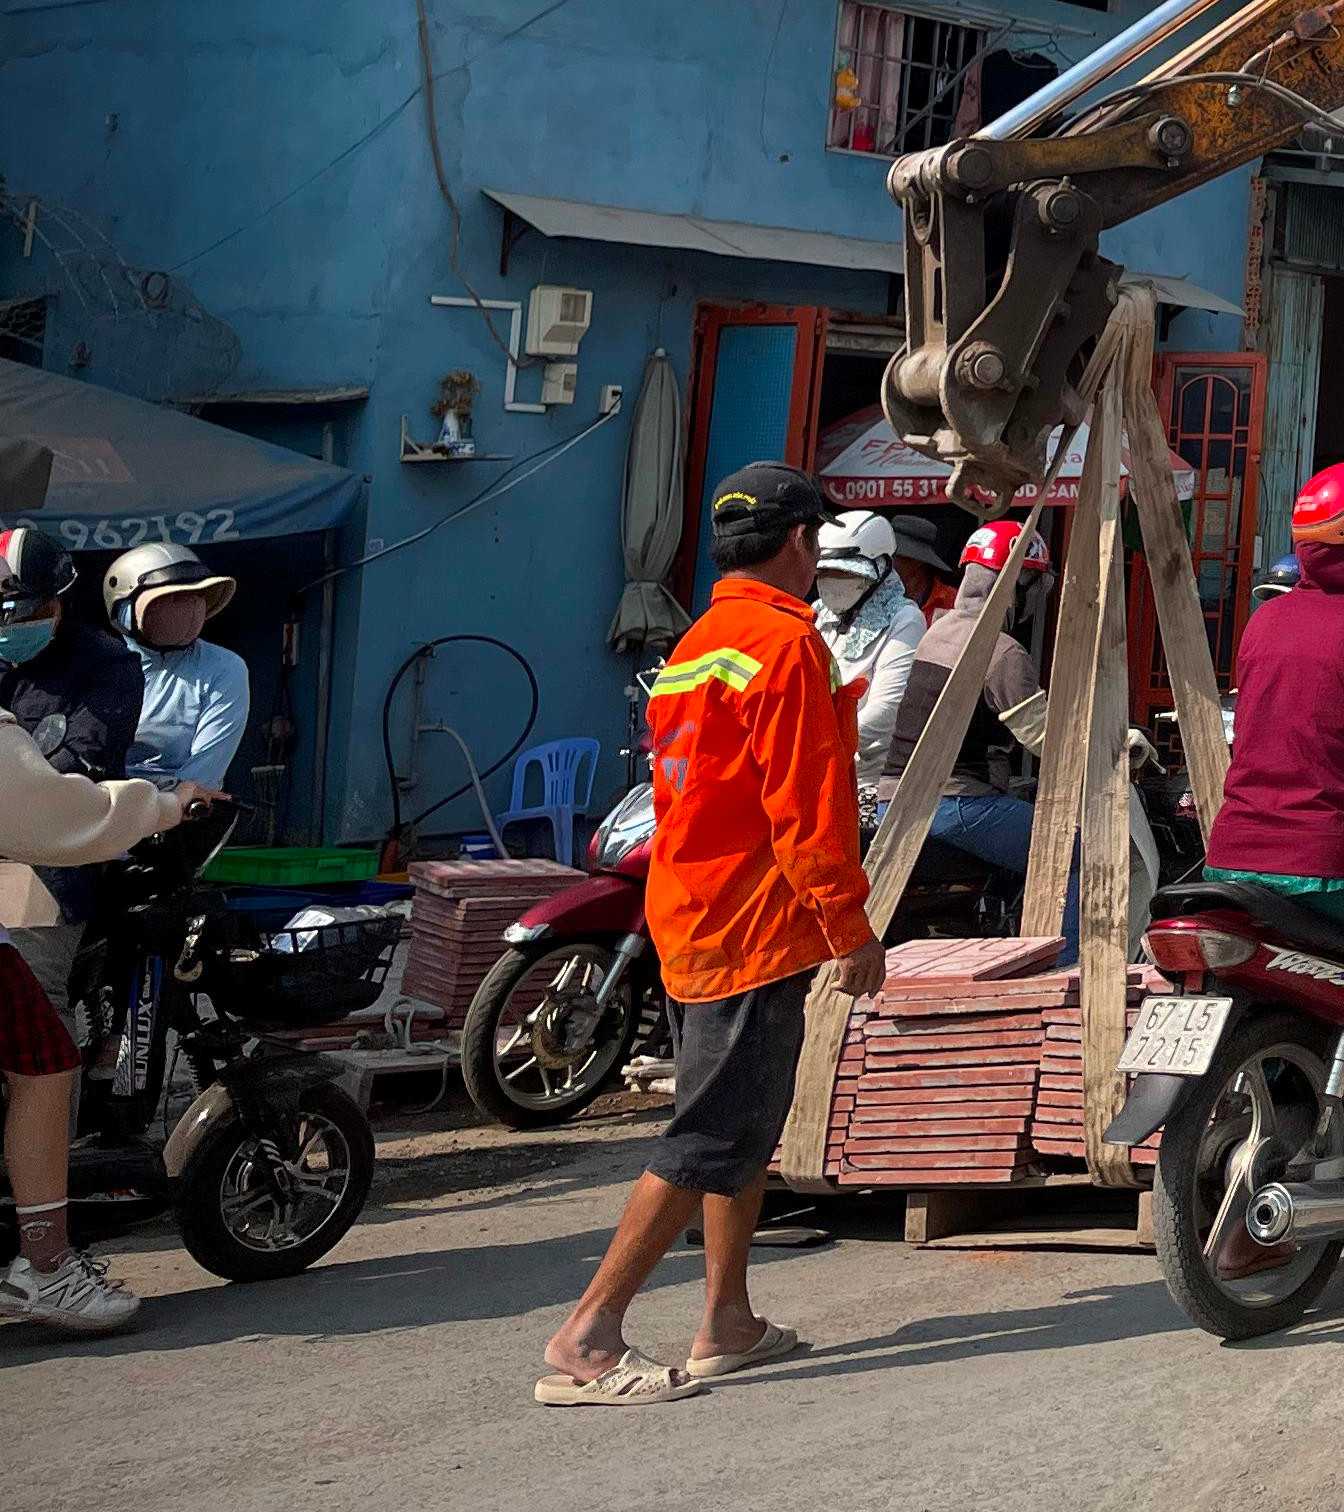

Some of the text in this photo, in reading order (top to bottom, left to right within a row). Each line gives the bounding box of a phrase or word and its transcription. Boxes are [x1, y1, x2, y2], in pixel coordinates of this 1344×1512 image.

[846, 479, 937, 500] 0901 55 31
[1046, 482, 1079, 498] CAM
[60, 508, 240, 550] 962192
[1132, 1035, 1202, 1067] 7215
